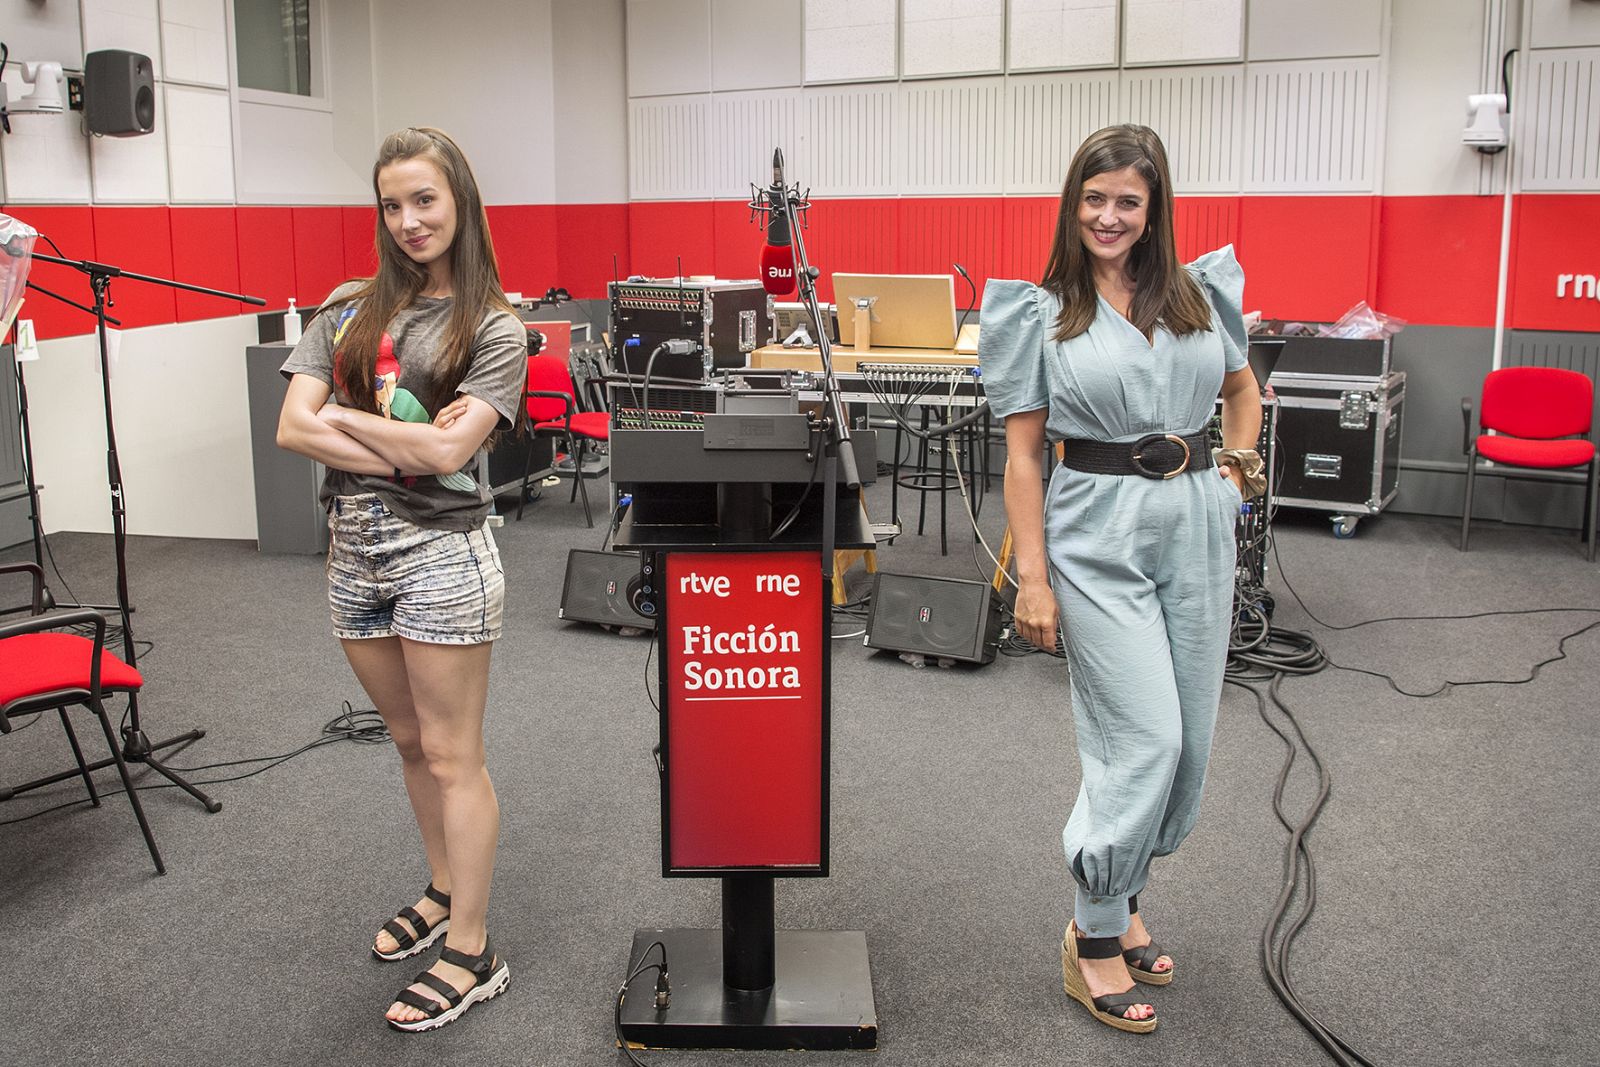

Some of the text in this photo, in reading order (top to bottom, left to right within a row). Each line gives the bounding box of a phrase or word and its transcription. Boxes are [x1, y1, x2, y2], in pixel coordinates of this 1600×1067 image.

[768, 266, 792, 278] rne
[1556, 273, 1600, 302] rn
[680, 572, 801, 597] rtve rne
[682, 623, 801, 654] Ficción
[684, 661, 801, 690] Sonora
